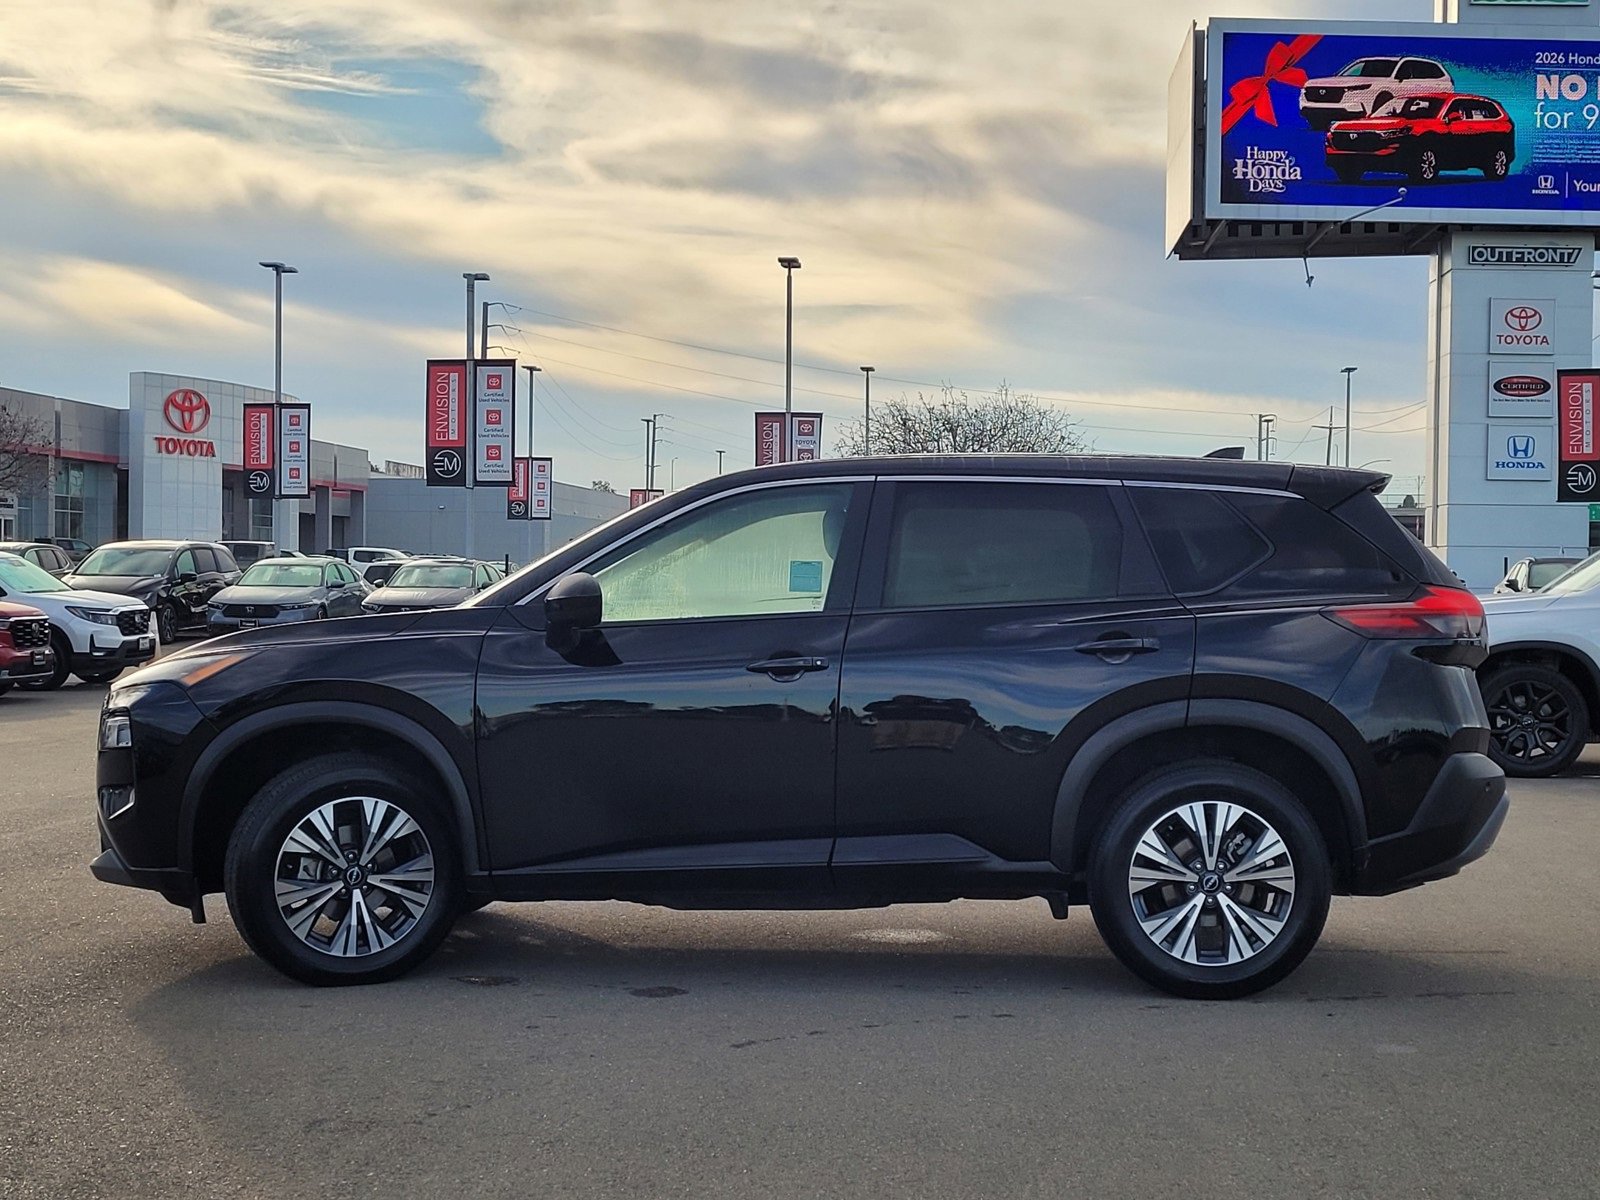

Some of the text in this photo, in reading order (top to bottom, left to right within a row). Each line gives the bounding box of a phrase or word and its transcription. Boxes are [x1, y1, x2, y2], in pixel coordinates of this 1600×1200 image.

[1535, 52, 1565, 64] 2026
[1536, 74, 1588, 101] NO
[1534, 101, 1574, 129] for
[1246, 146, 1289, 164] Happy
[1232, 158, 1303, 180] Honda
[1249, 178, 1287, 193] Days
[1496, 334, 1550, 346] TOYOTA
[436, 372, 449, 441] ENVISION
[1568, 382, 1583, 454] ENVISION
[154, 436, 217, 458] TOYOTA
[250, 412, 260, 465] ENVISION
[762, 422, 773, 465] NVISION
[1495, 461, 1546, 469] HONDA
